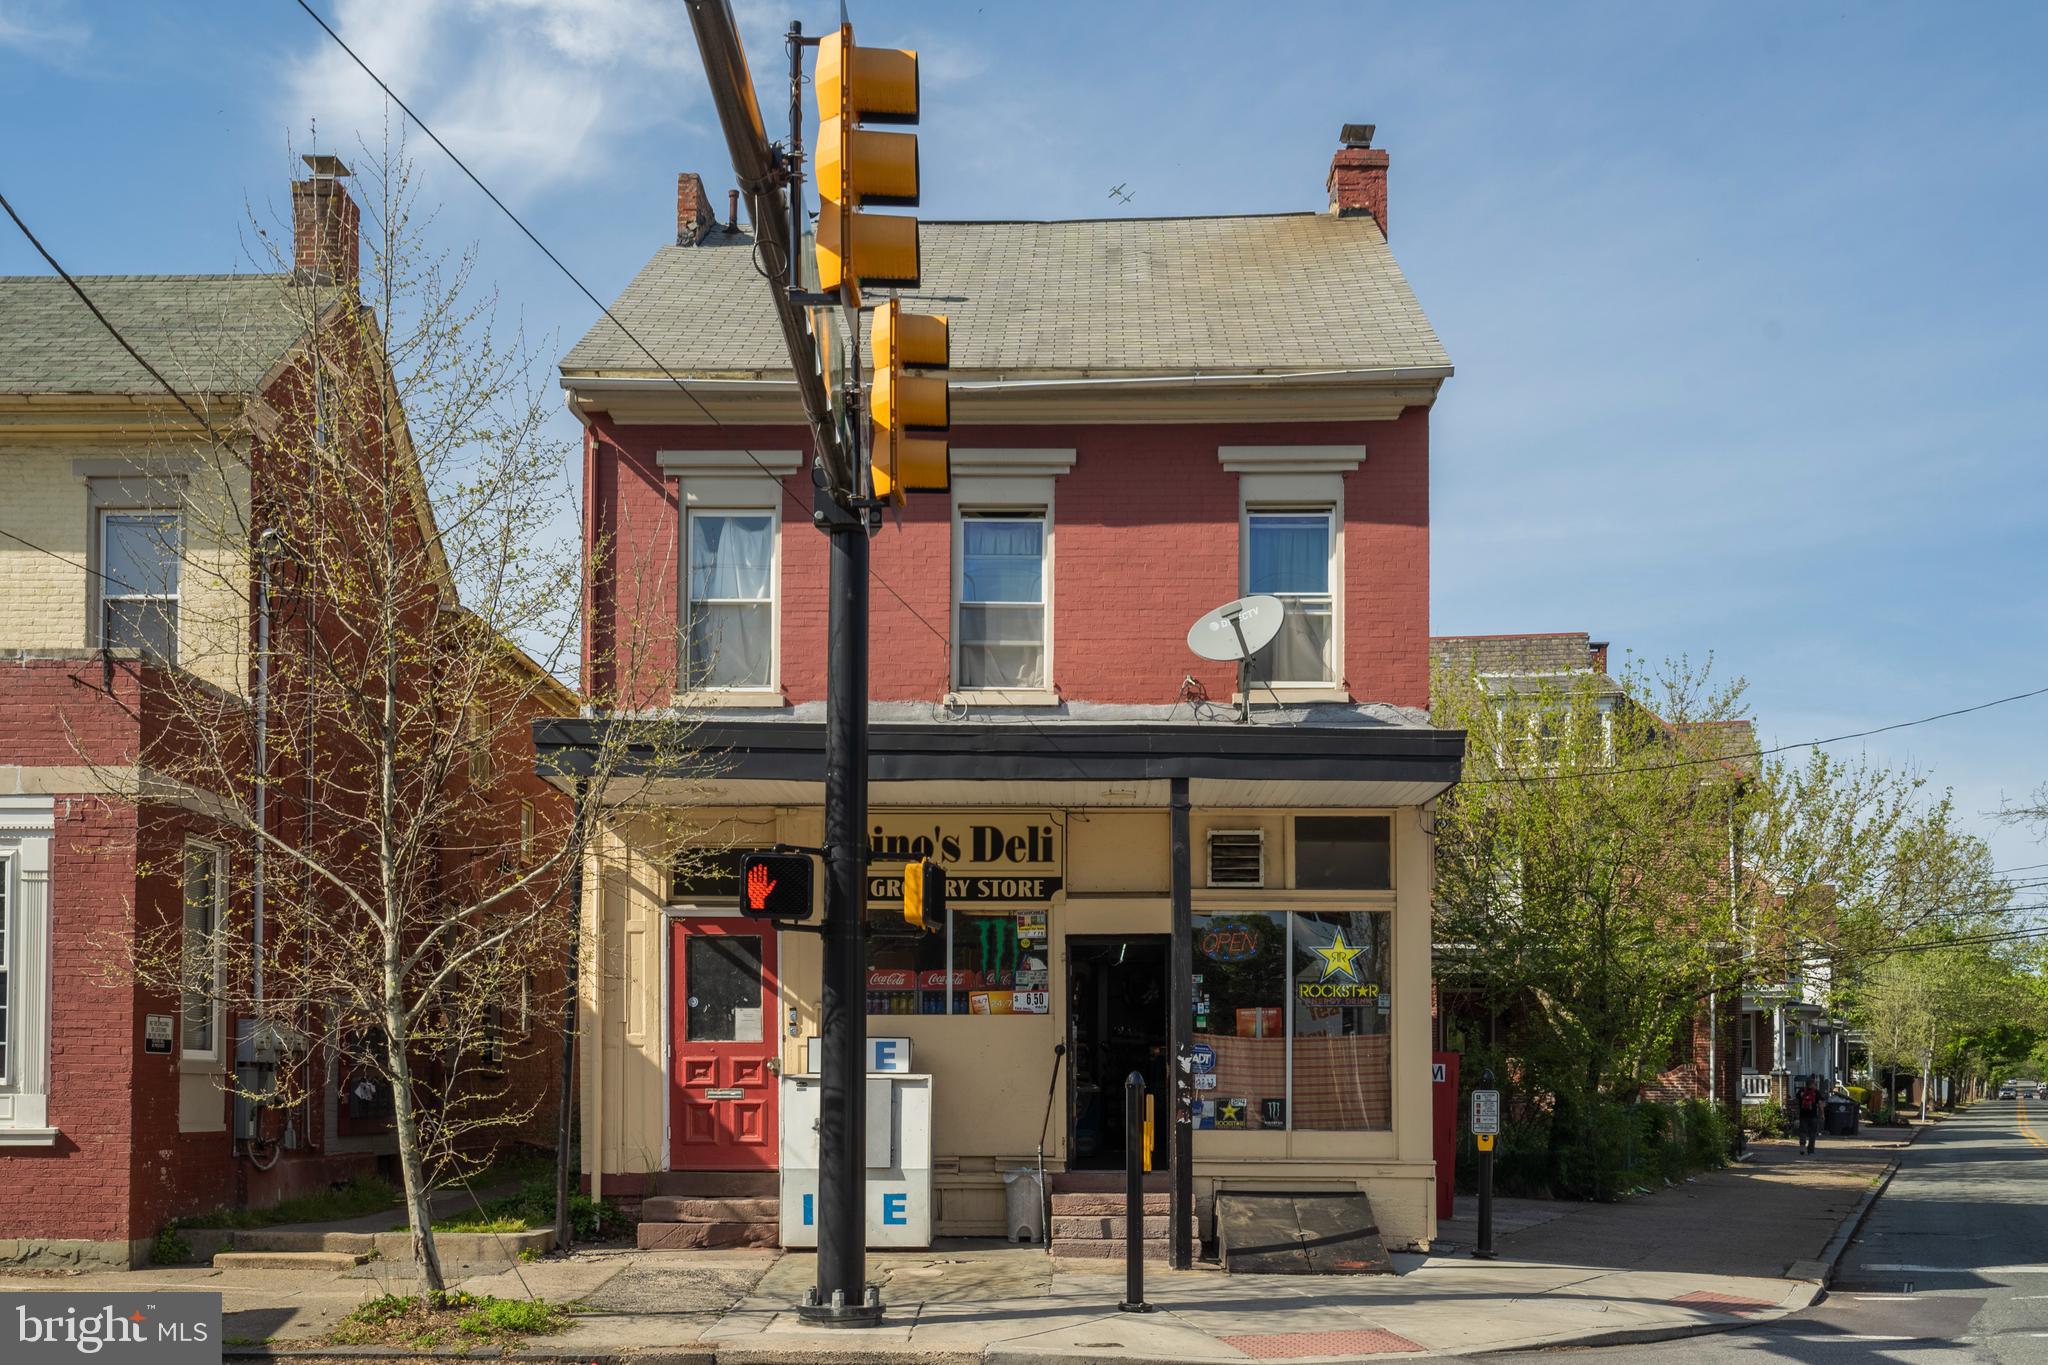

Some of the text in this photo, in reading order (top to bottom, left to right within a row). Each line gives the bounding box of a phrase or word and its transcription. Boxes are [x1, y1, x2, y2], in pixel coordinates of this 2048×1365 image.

[1220, 607, 1259, 628] DIECTV
[969, 826, 1055, 863] Deli
[978, 879, 1044, 897] STORE
[1202, 931, 1259, 956] OPEN
[1026, 993, 1044, 1006] 6.50
[1192, 1053, 1212, 1065] ADT
